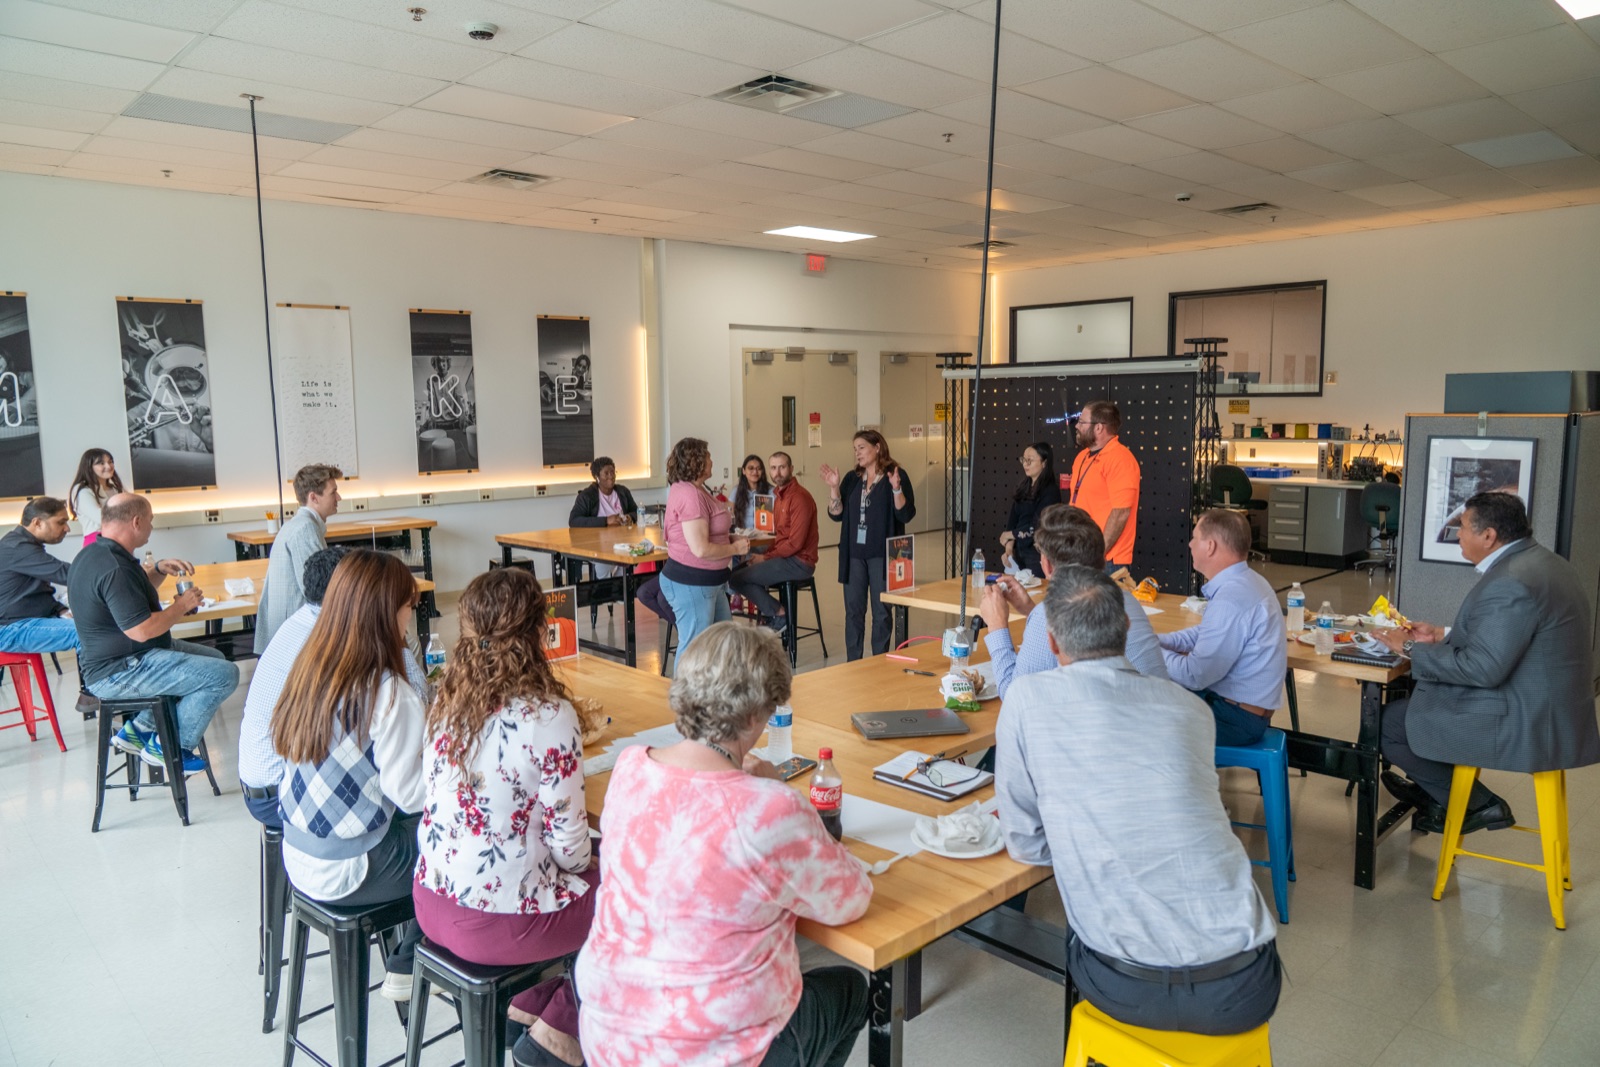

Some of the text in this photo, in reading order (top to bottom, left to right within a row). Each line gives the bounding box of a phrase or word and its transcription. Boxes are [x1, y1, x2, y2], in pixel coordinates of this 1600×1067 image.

[809, 255, 825, 271] EXIT
[145, 373, 193, 425] A
[430, 374, 463, 418] K
[555, 375, 580, 415] E
[545, 590, 567, 604] able
